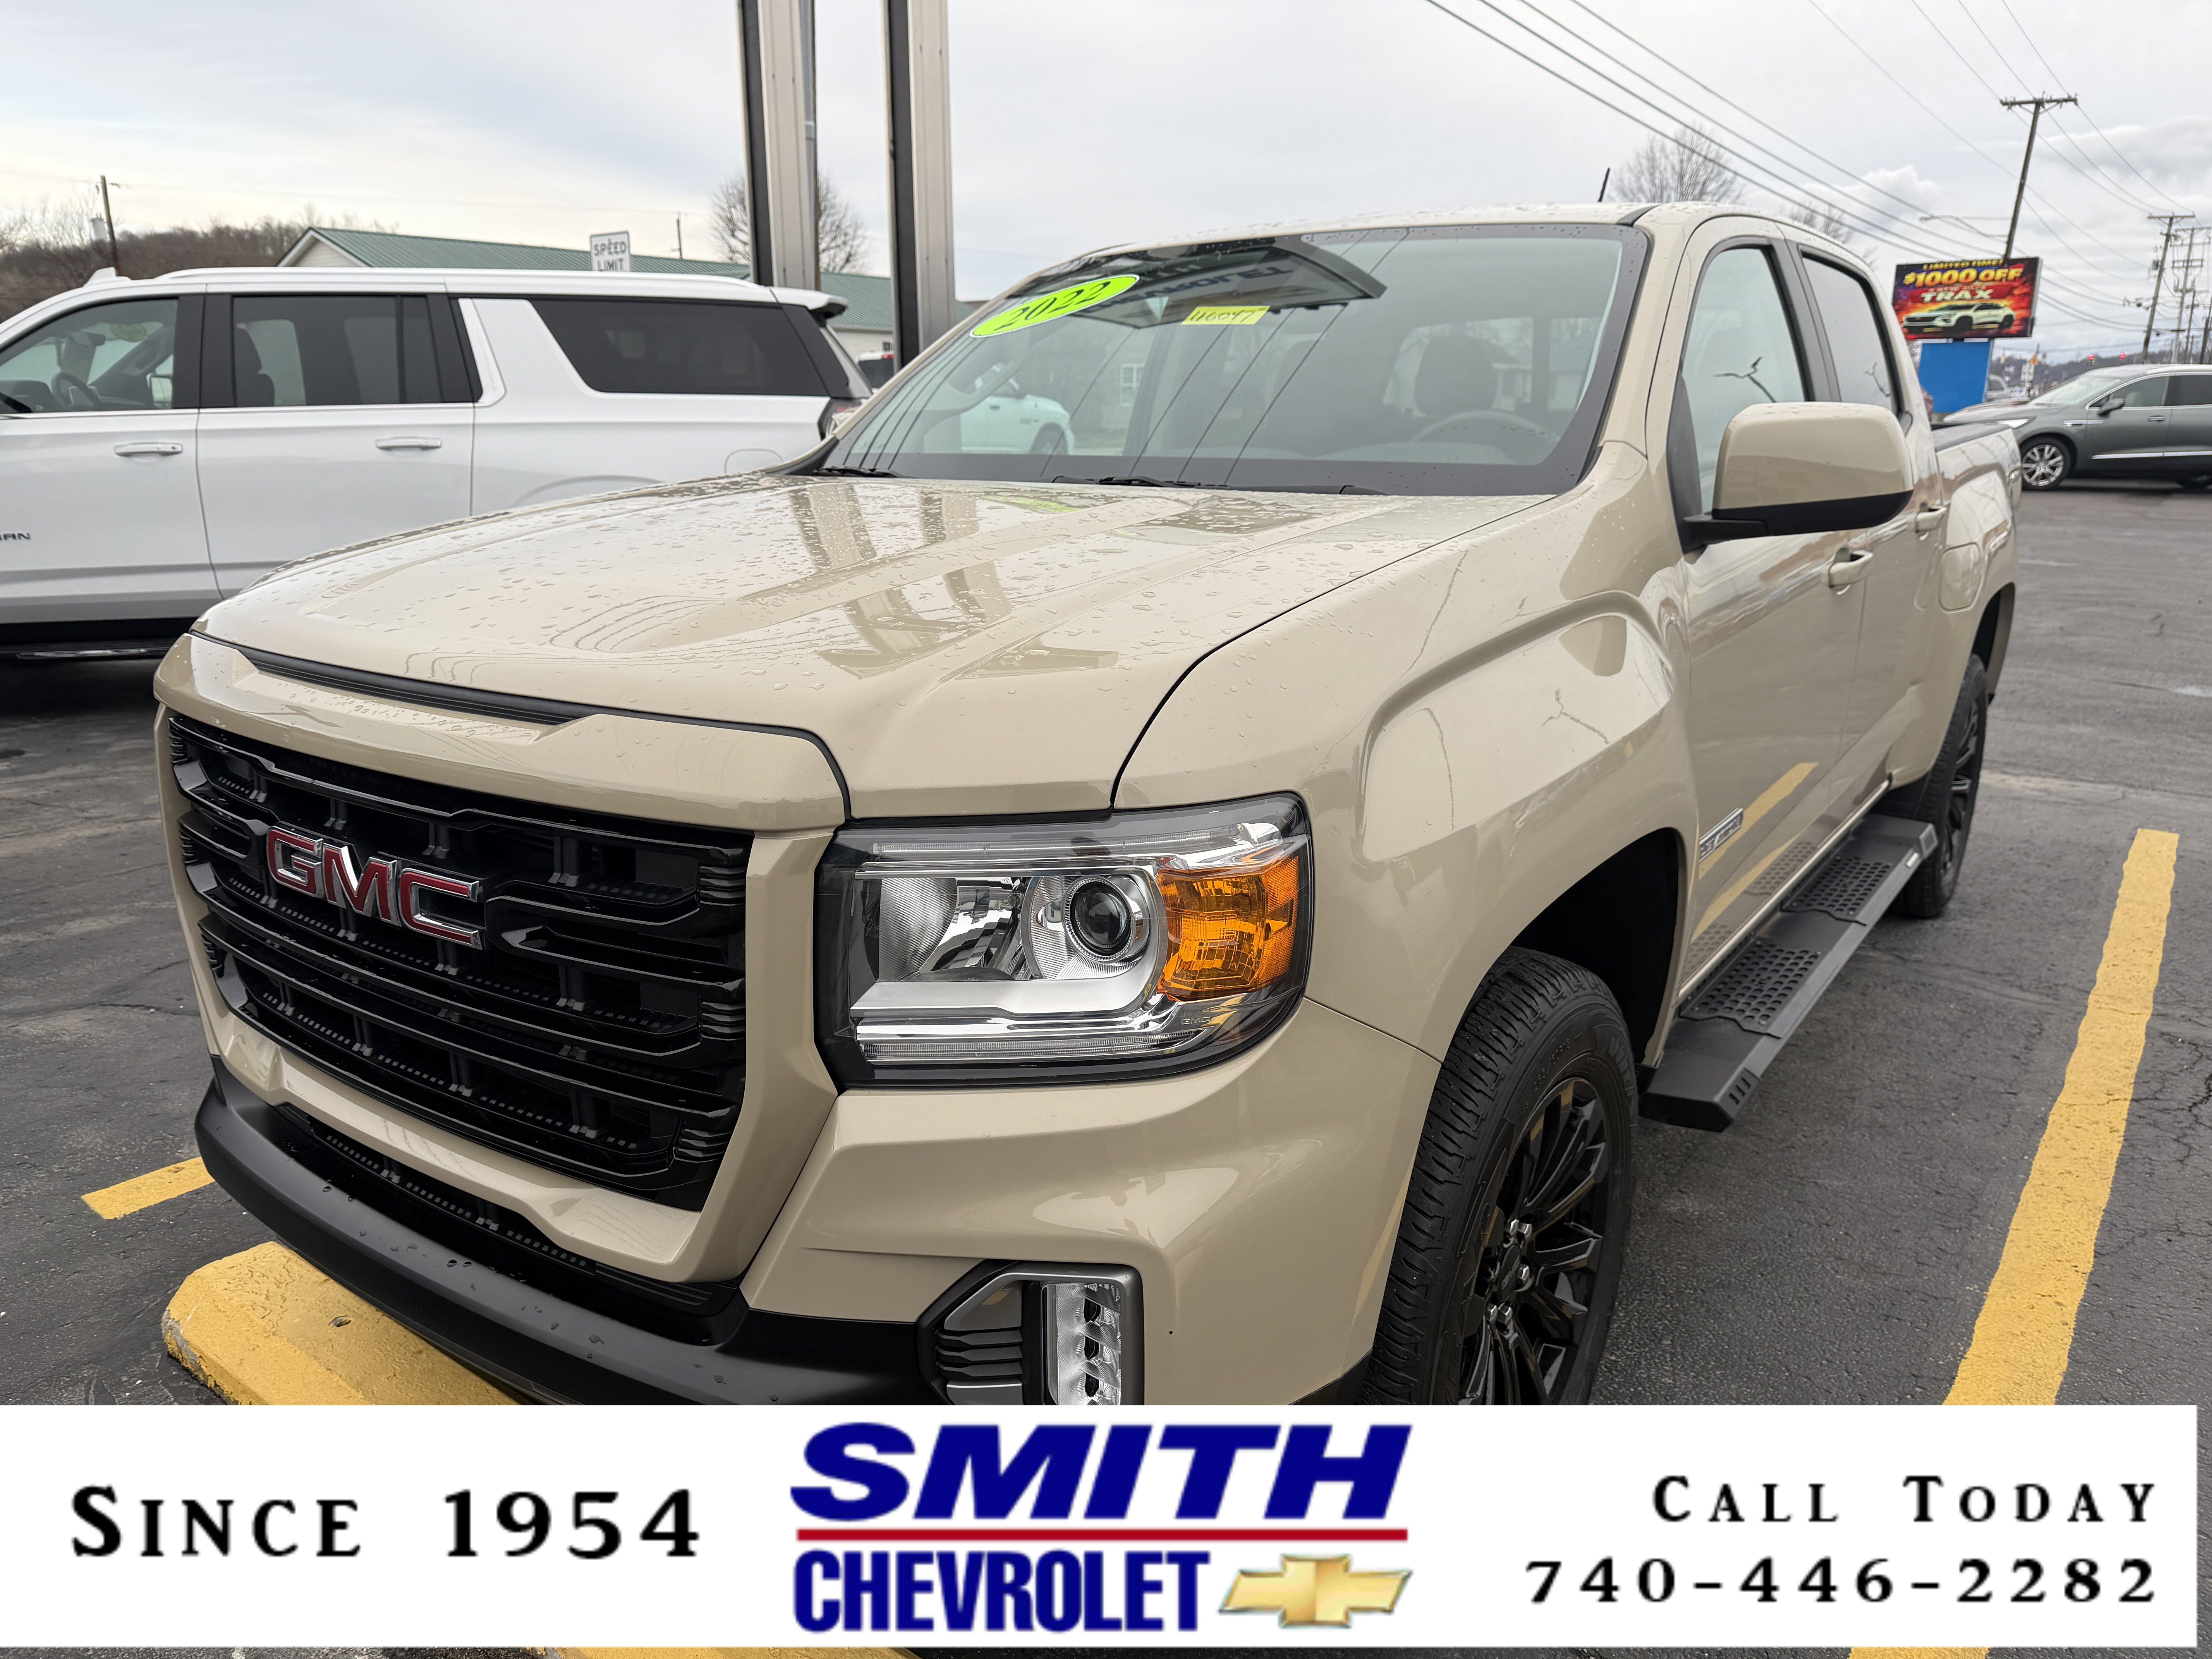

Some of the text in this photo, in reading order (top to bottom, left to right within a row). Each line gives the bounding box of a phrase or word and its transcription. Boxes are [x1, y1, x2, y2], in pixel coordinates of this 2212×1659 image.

[593, 241, 627, 256] SPEED
[597, 258, 624, 271] LIMIT
[1923, 260, 1970, 270] LIMITED
[1903, 268, 1977, 287] $1000
[1978, 268, 2024, 282] OFF
[1920, 289, 1994, 303] TRAX
[994, 281, 1111, 331] 2022
[266, 826, 483, 950] GMC
